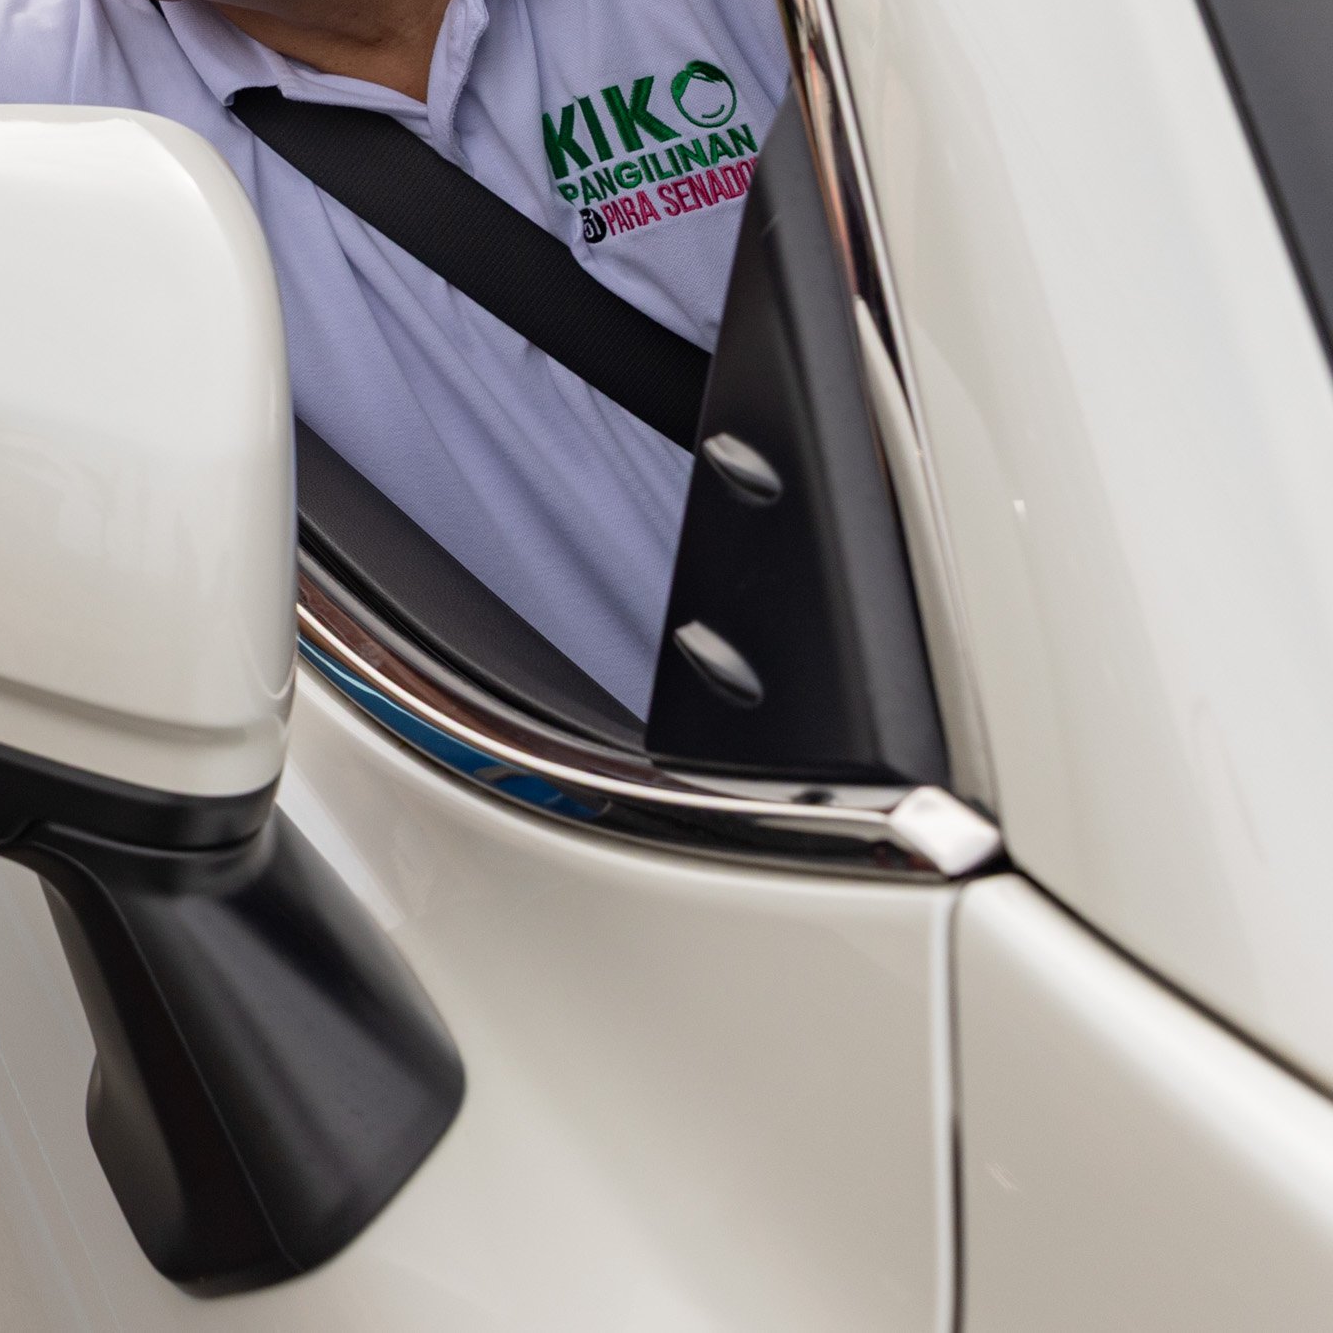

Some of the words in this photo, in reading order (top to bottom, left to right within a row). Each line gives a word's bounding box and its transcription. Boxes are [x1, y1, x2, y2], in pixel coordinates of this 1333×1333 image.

[557, 124, 759, 207] PANGILINAN
[600, 191, 662, 236] PARA
[657, 157, 758, 217] SENADO
